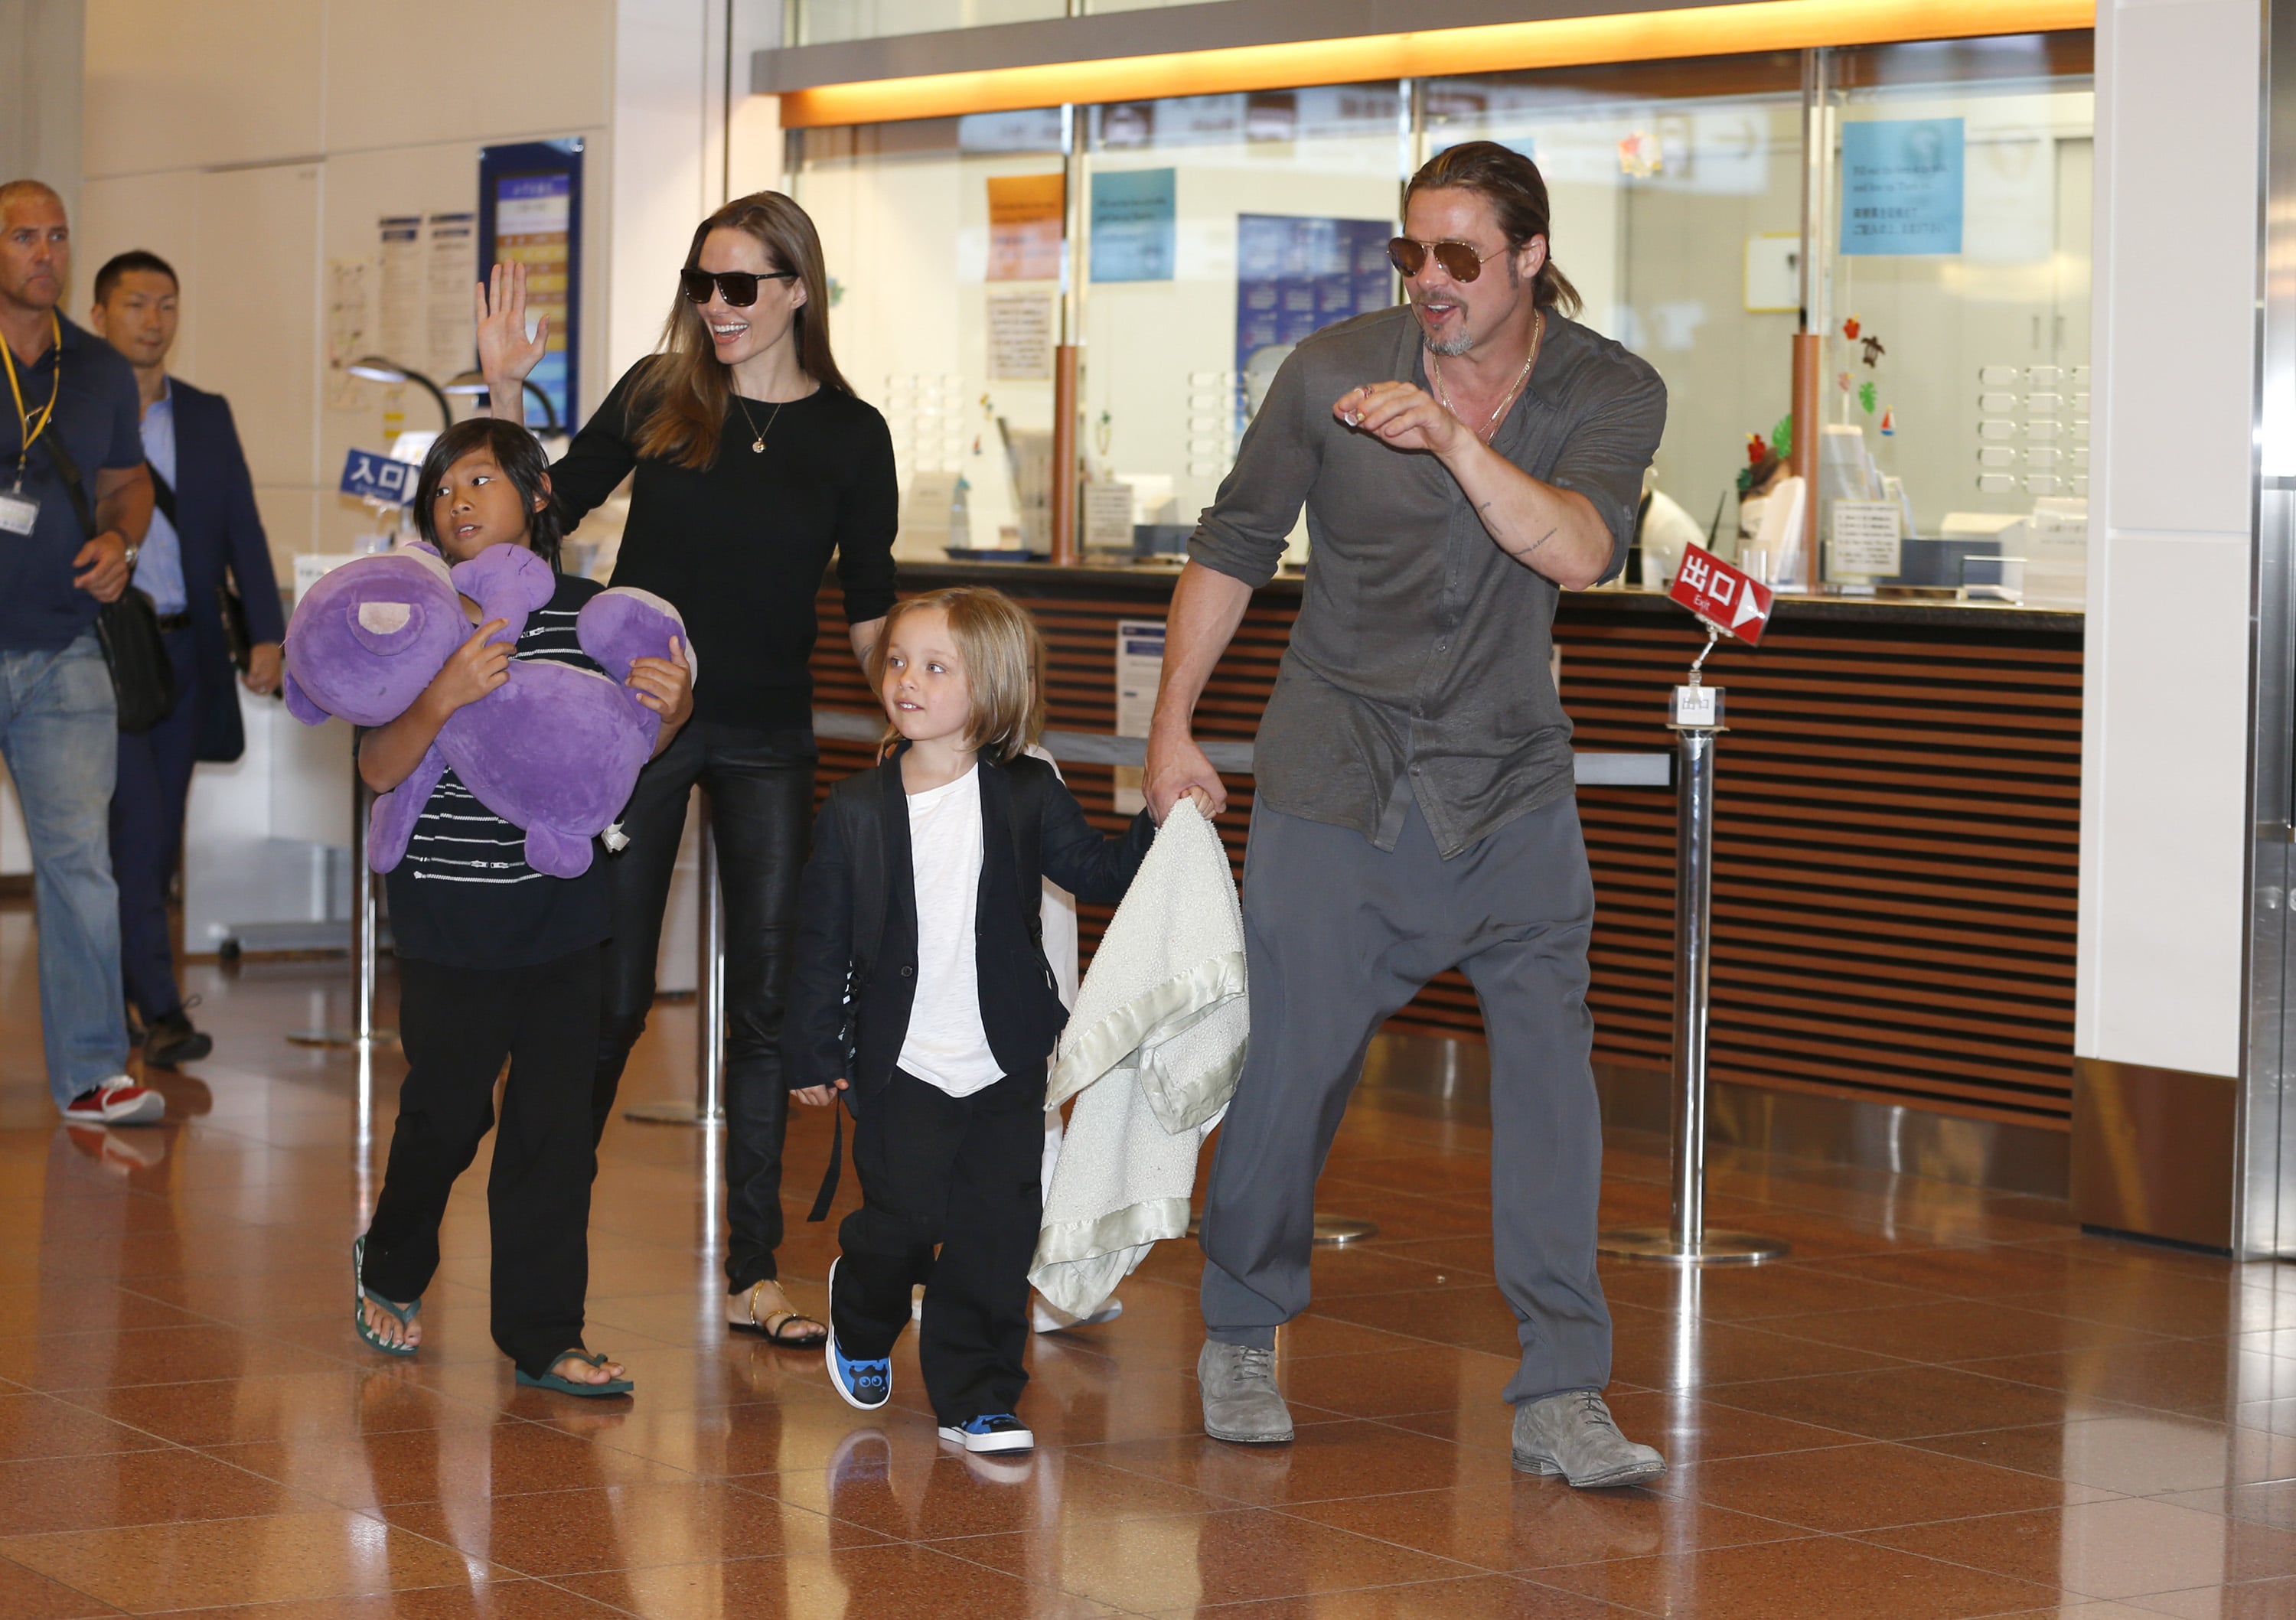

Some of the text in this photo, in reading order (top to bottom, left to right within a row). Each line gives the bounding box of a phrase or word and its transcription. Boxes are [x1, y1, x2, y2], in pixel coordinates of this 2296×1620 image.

[350, 457, 406, 491] 入口
[1680, 555, 1736, 606] 出口
[1694, 594, 1711, 611] Exit
